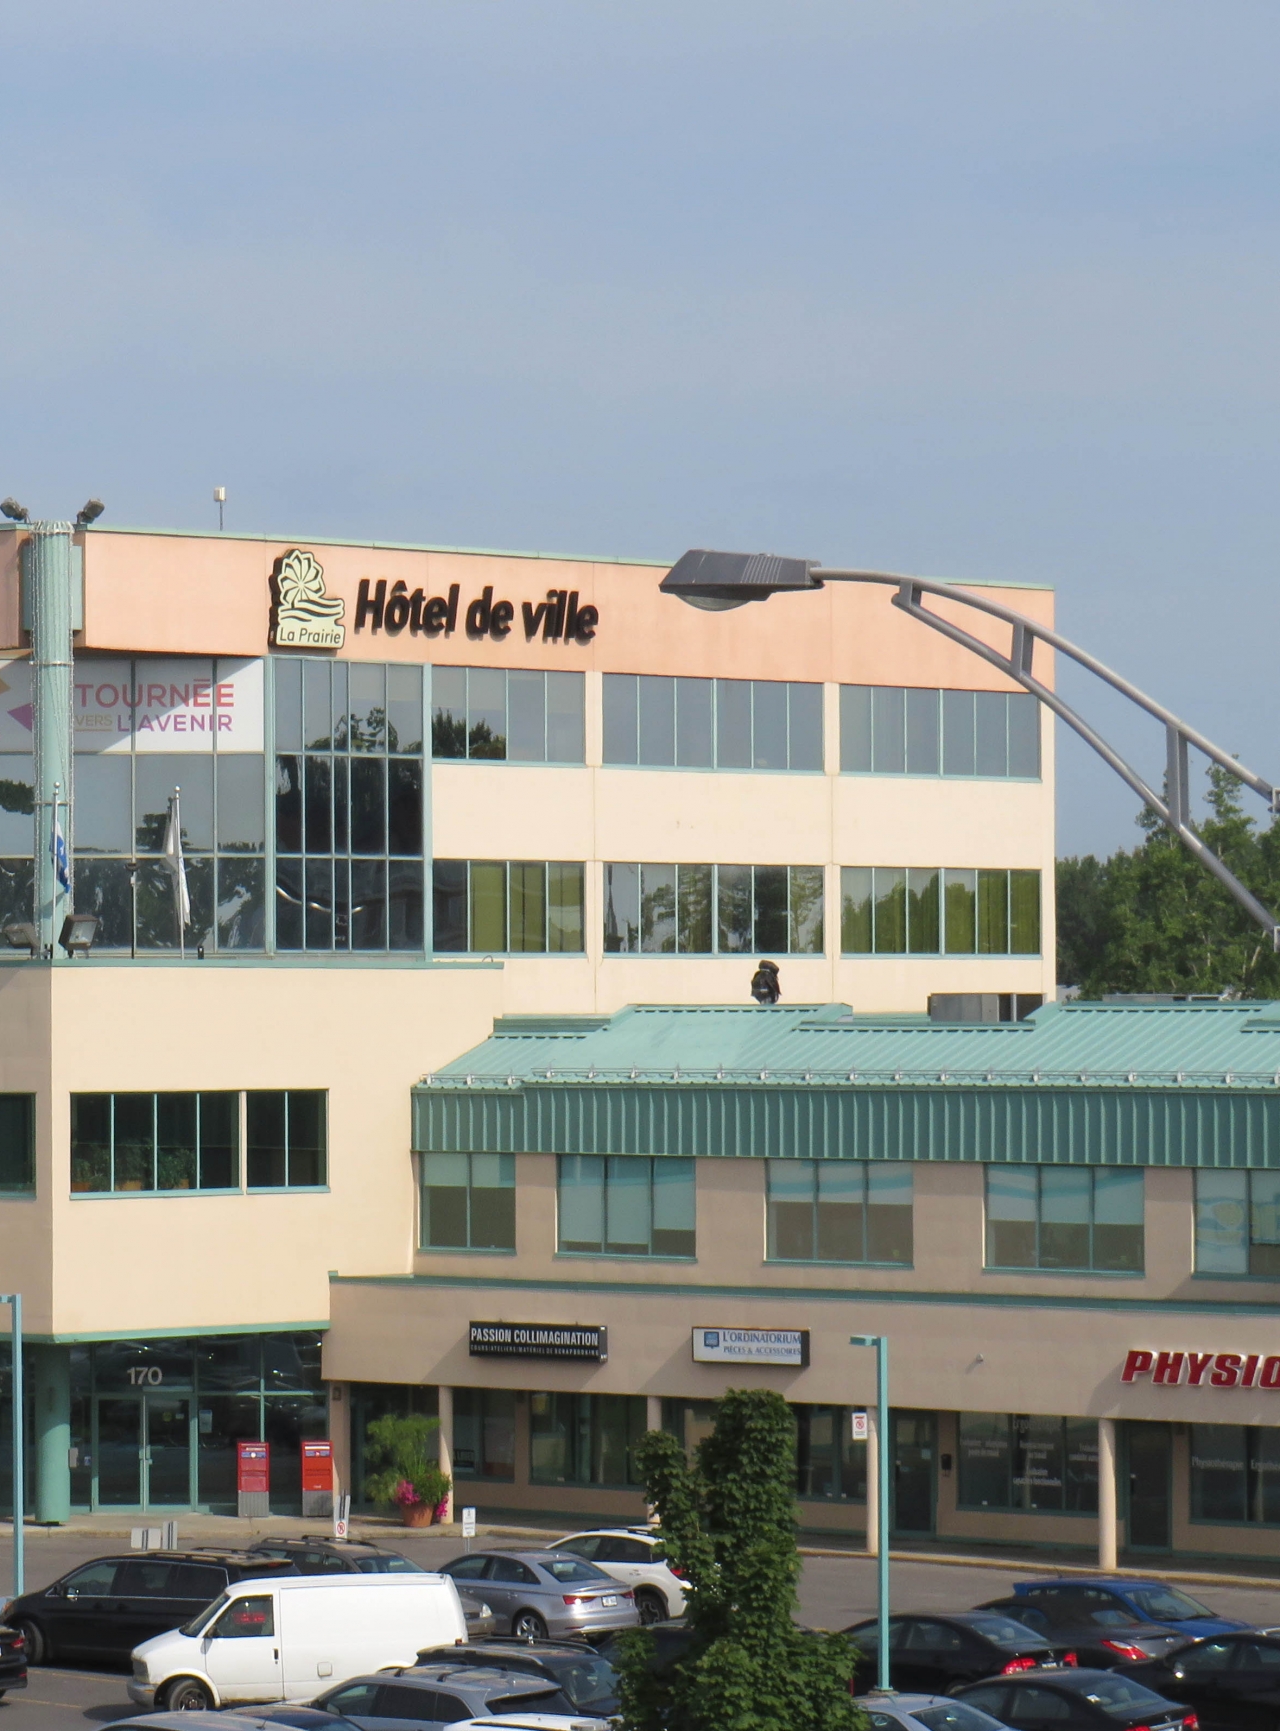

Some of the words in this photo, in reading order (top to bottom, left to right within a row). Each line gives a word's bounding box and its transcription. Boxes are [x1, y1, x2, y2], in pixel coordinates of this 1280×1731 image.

[354, 579, 460, 635] Hôtel
[466, 586, 514, 637] de
[522, 589, 599, 641] ville
[280, 627, 295, 642] La
[299, 627, 341, 644] Prairie
[74, 713, 113, 727] VERS
[117, 714, 233, 732] L'AVENIR
[471, 1327, 512, 1343] PASSION
[513, 1329, 598, 1346] COLLIMAGINATION
[722, 1331, 801, 1344] L'ORDINATORIUM
[127, 1366, 163, 1385] 170
[1120, 1349, 1280, 1388] PHYSIO
